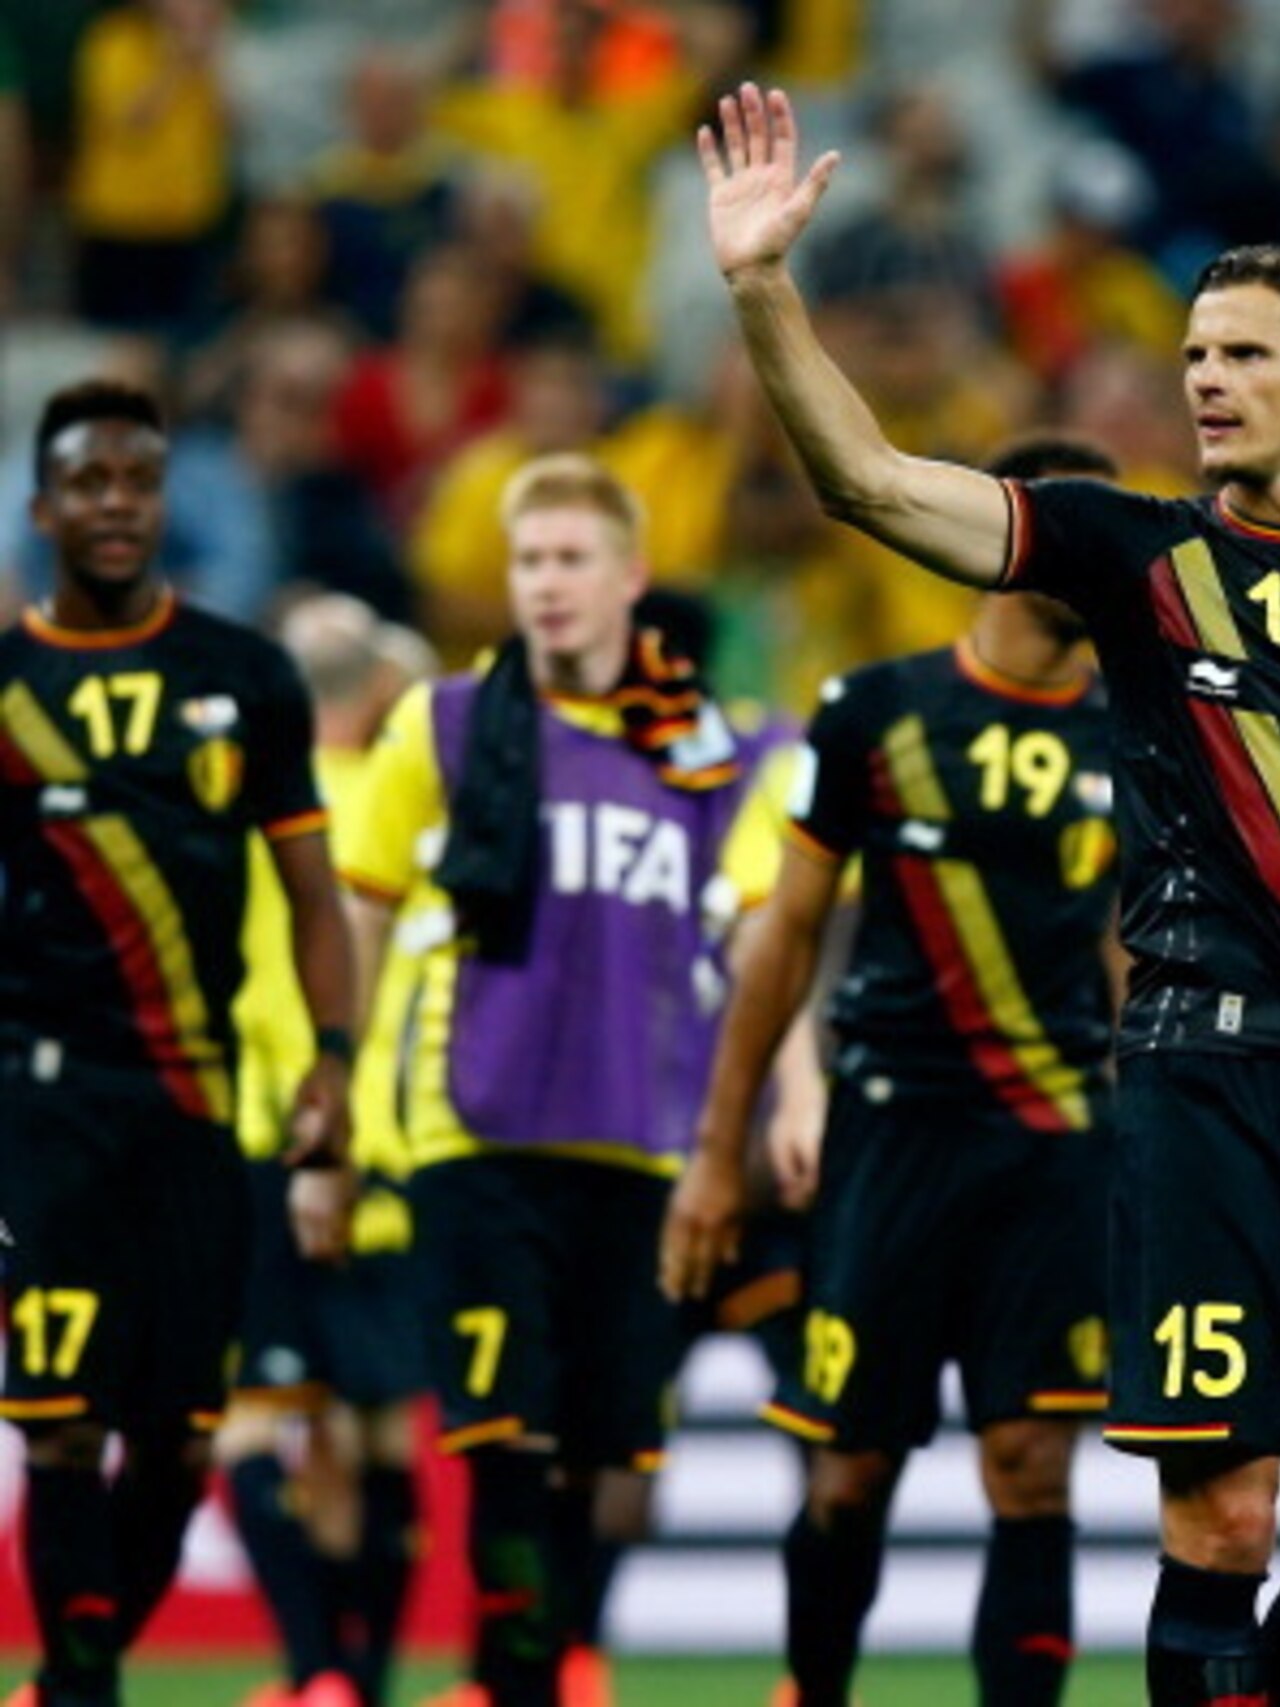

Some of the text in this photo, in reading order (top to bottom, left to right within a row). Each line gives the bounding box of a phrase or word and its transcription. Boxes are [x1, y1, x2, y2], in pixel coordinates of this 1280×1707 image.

[68, 672, 161, 758] 17
[968, 723, 1070, 817] 19
[540, 800, 690, 914] IFA
[12, 1288, 98, 1377] 17
[455, 1307, 507, 1395] 7
[805, 1309, 856, 1402] 19
[1153, 1301, 1247, 1398] 15
